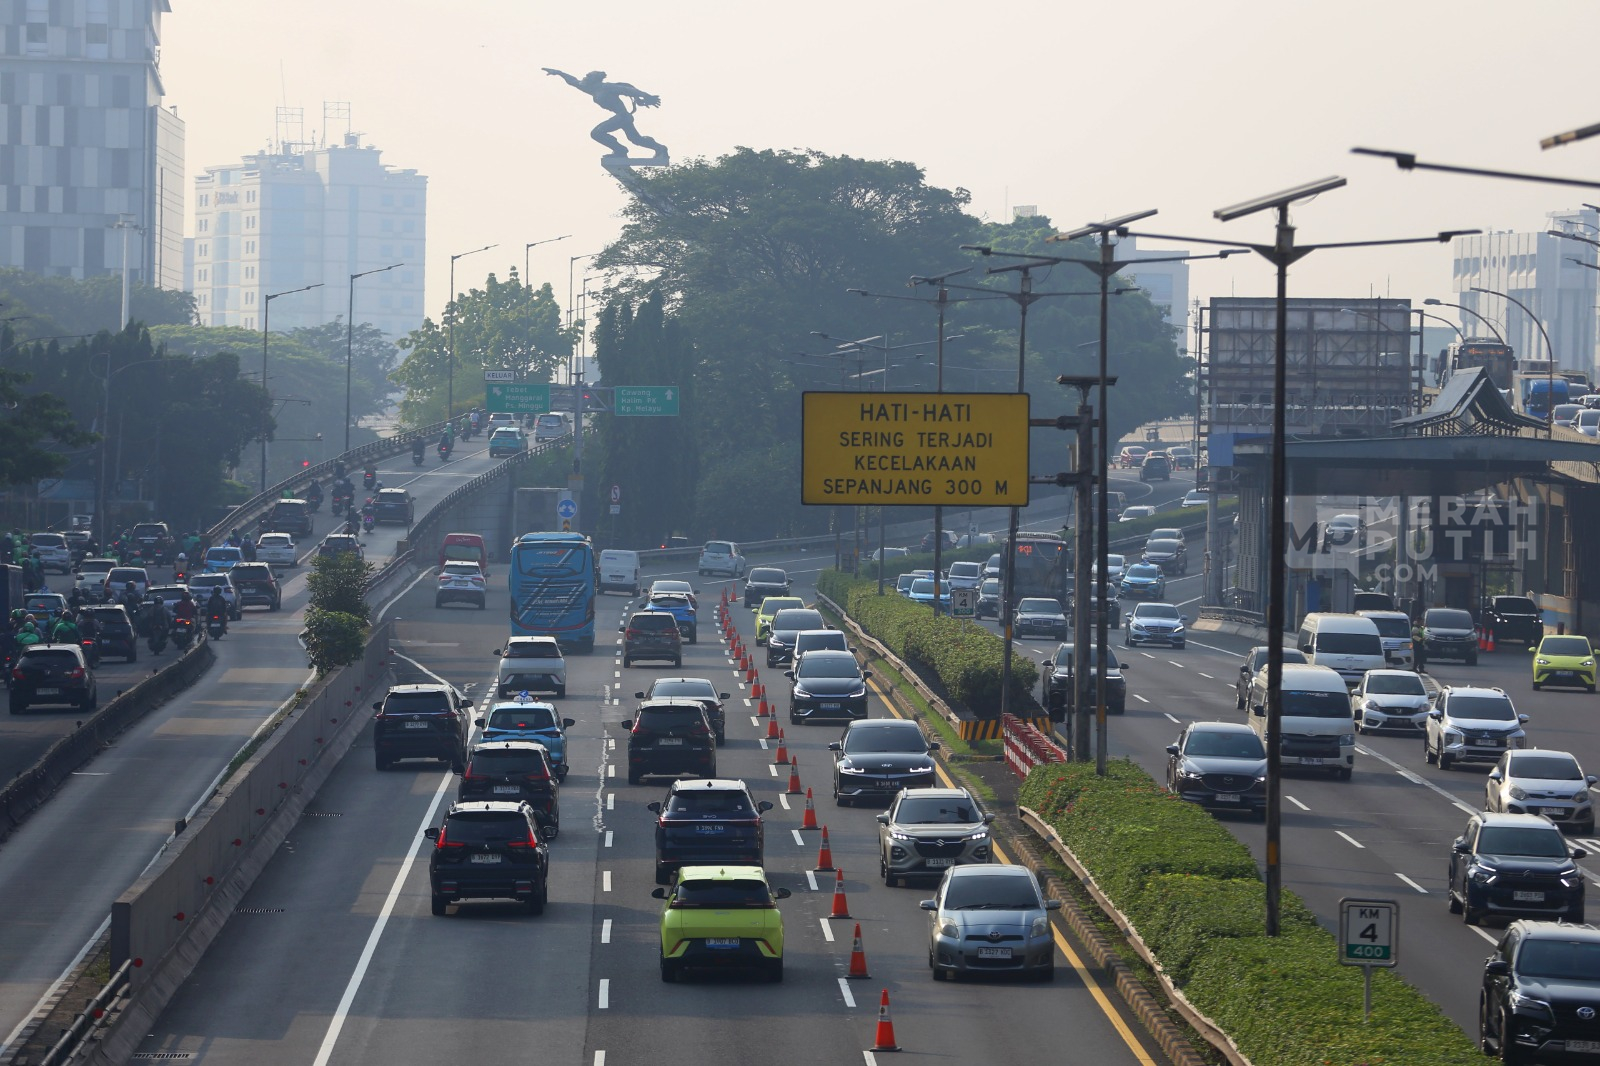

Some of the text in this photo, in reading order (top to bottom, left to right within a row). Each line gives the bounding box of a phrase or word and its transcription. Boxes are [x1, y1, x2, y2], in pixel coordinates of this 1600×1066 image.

[621, 389, 651, 397] Cawang
[860, 403, 972, 422] HATI-HATI
[839, 431, 993, 448] SERING TERJADI
[854, 455, 977, 472] KECELAKAAN
[823, 478, 1008, 496] SEPANJANG 300 M
[959, 598, 968, 608] 4
[1359, 908, 1380, 919] KM
[1359, 922, 1378, 943] 4
[1352, 945, 1384, 958] 400
